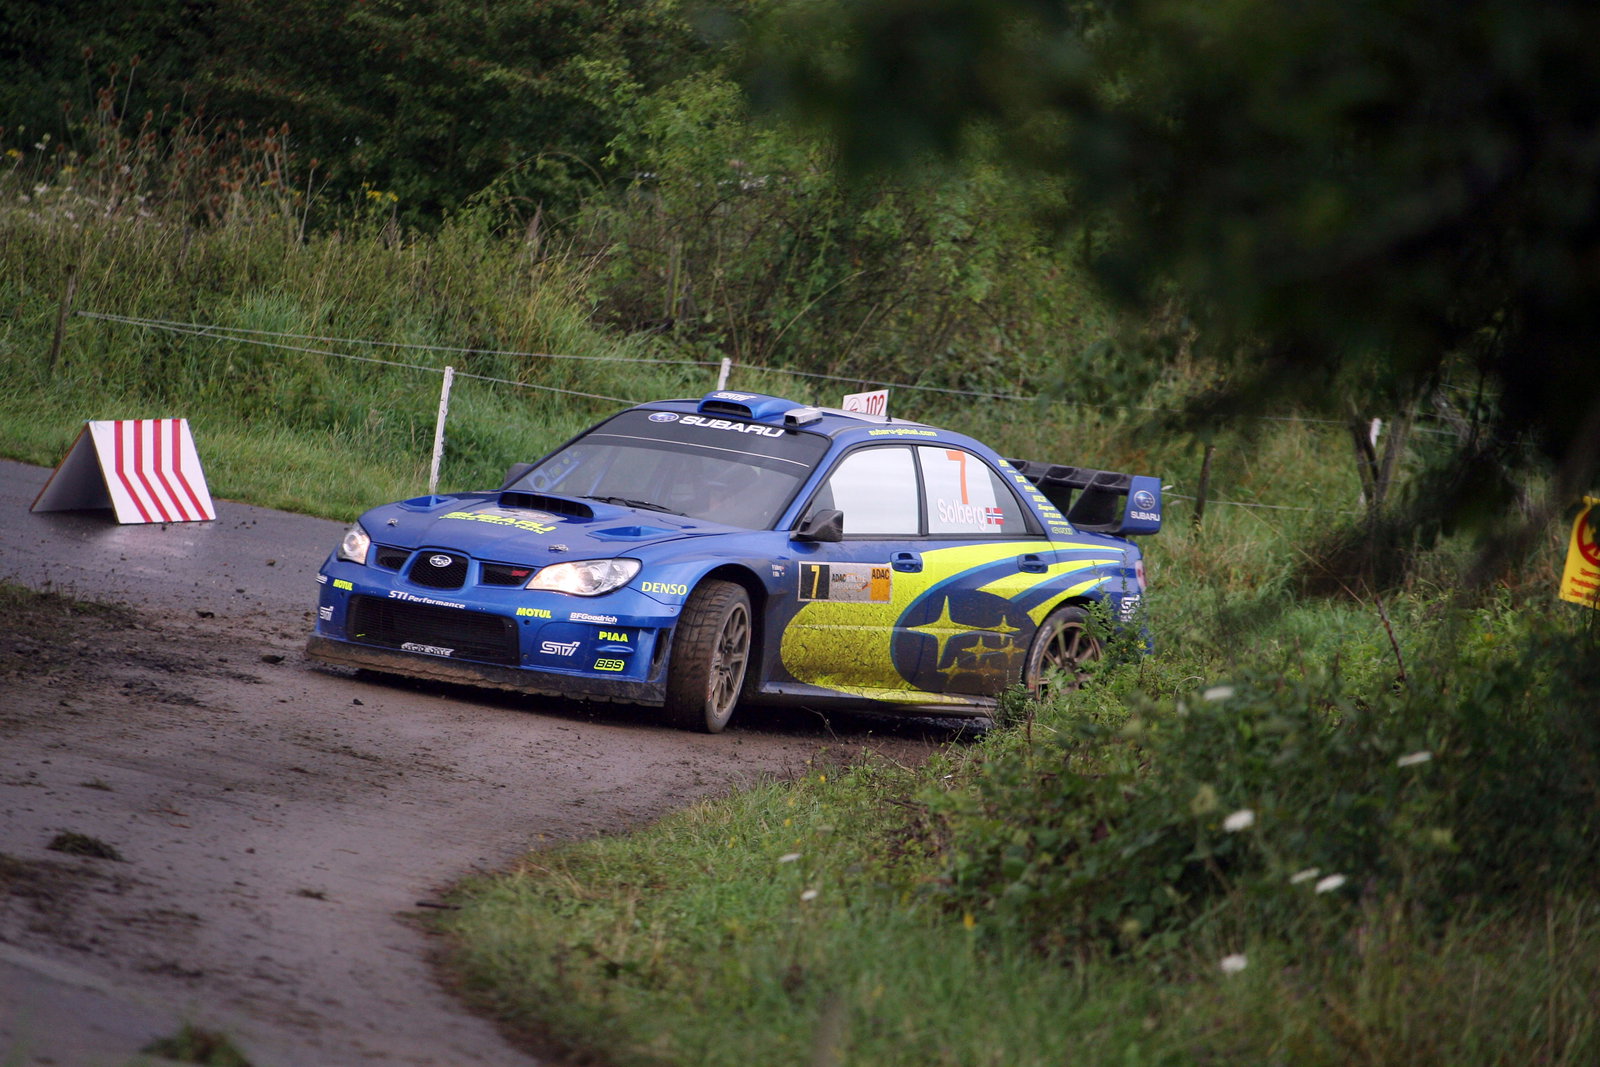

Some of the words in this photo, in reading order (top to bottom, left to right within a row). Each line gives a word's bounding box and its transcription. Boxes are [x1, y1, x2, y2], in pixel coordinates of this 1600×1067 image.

[866, 395, 884, 416] 102
[678, 415, 785, 438] SUBARU
[946, 450, 969, 505] 7
[440, 511, 557, 532] SUBARU
[937, 498, 986, 531] Solberg
[1130, 510, 1160, 522] SUBARU
[811, 564, 821, 599] 7
[871, 568, 890, 580] ADAC
[333, 578, 354, 591] MOTUL
[641, 581, 688, 596] DENSO
[408, 595, 466, 610] Performance
[516, 607, 552, 619] MOTUL
[569, 612, 618, 624] BFGoodrich
[599, 631, 629, 642] PIAA
[594, 659, 624, 670] BBS
